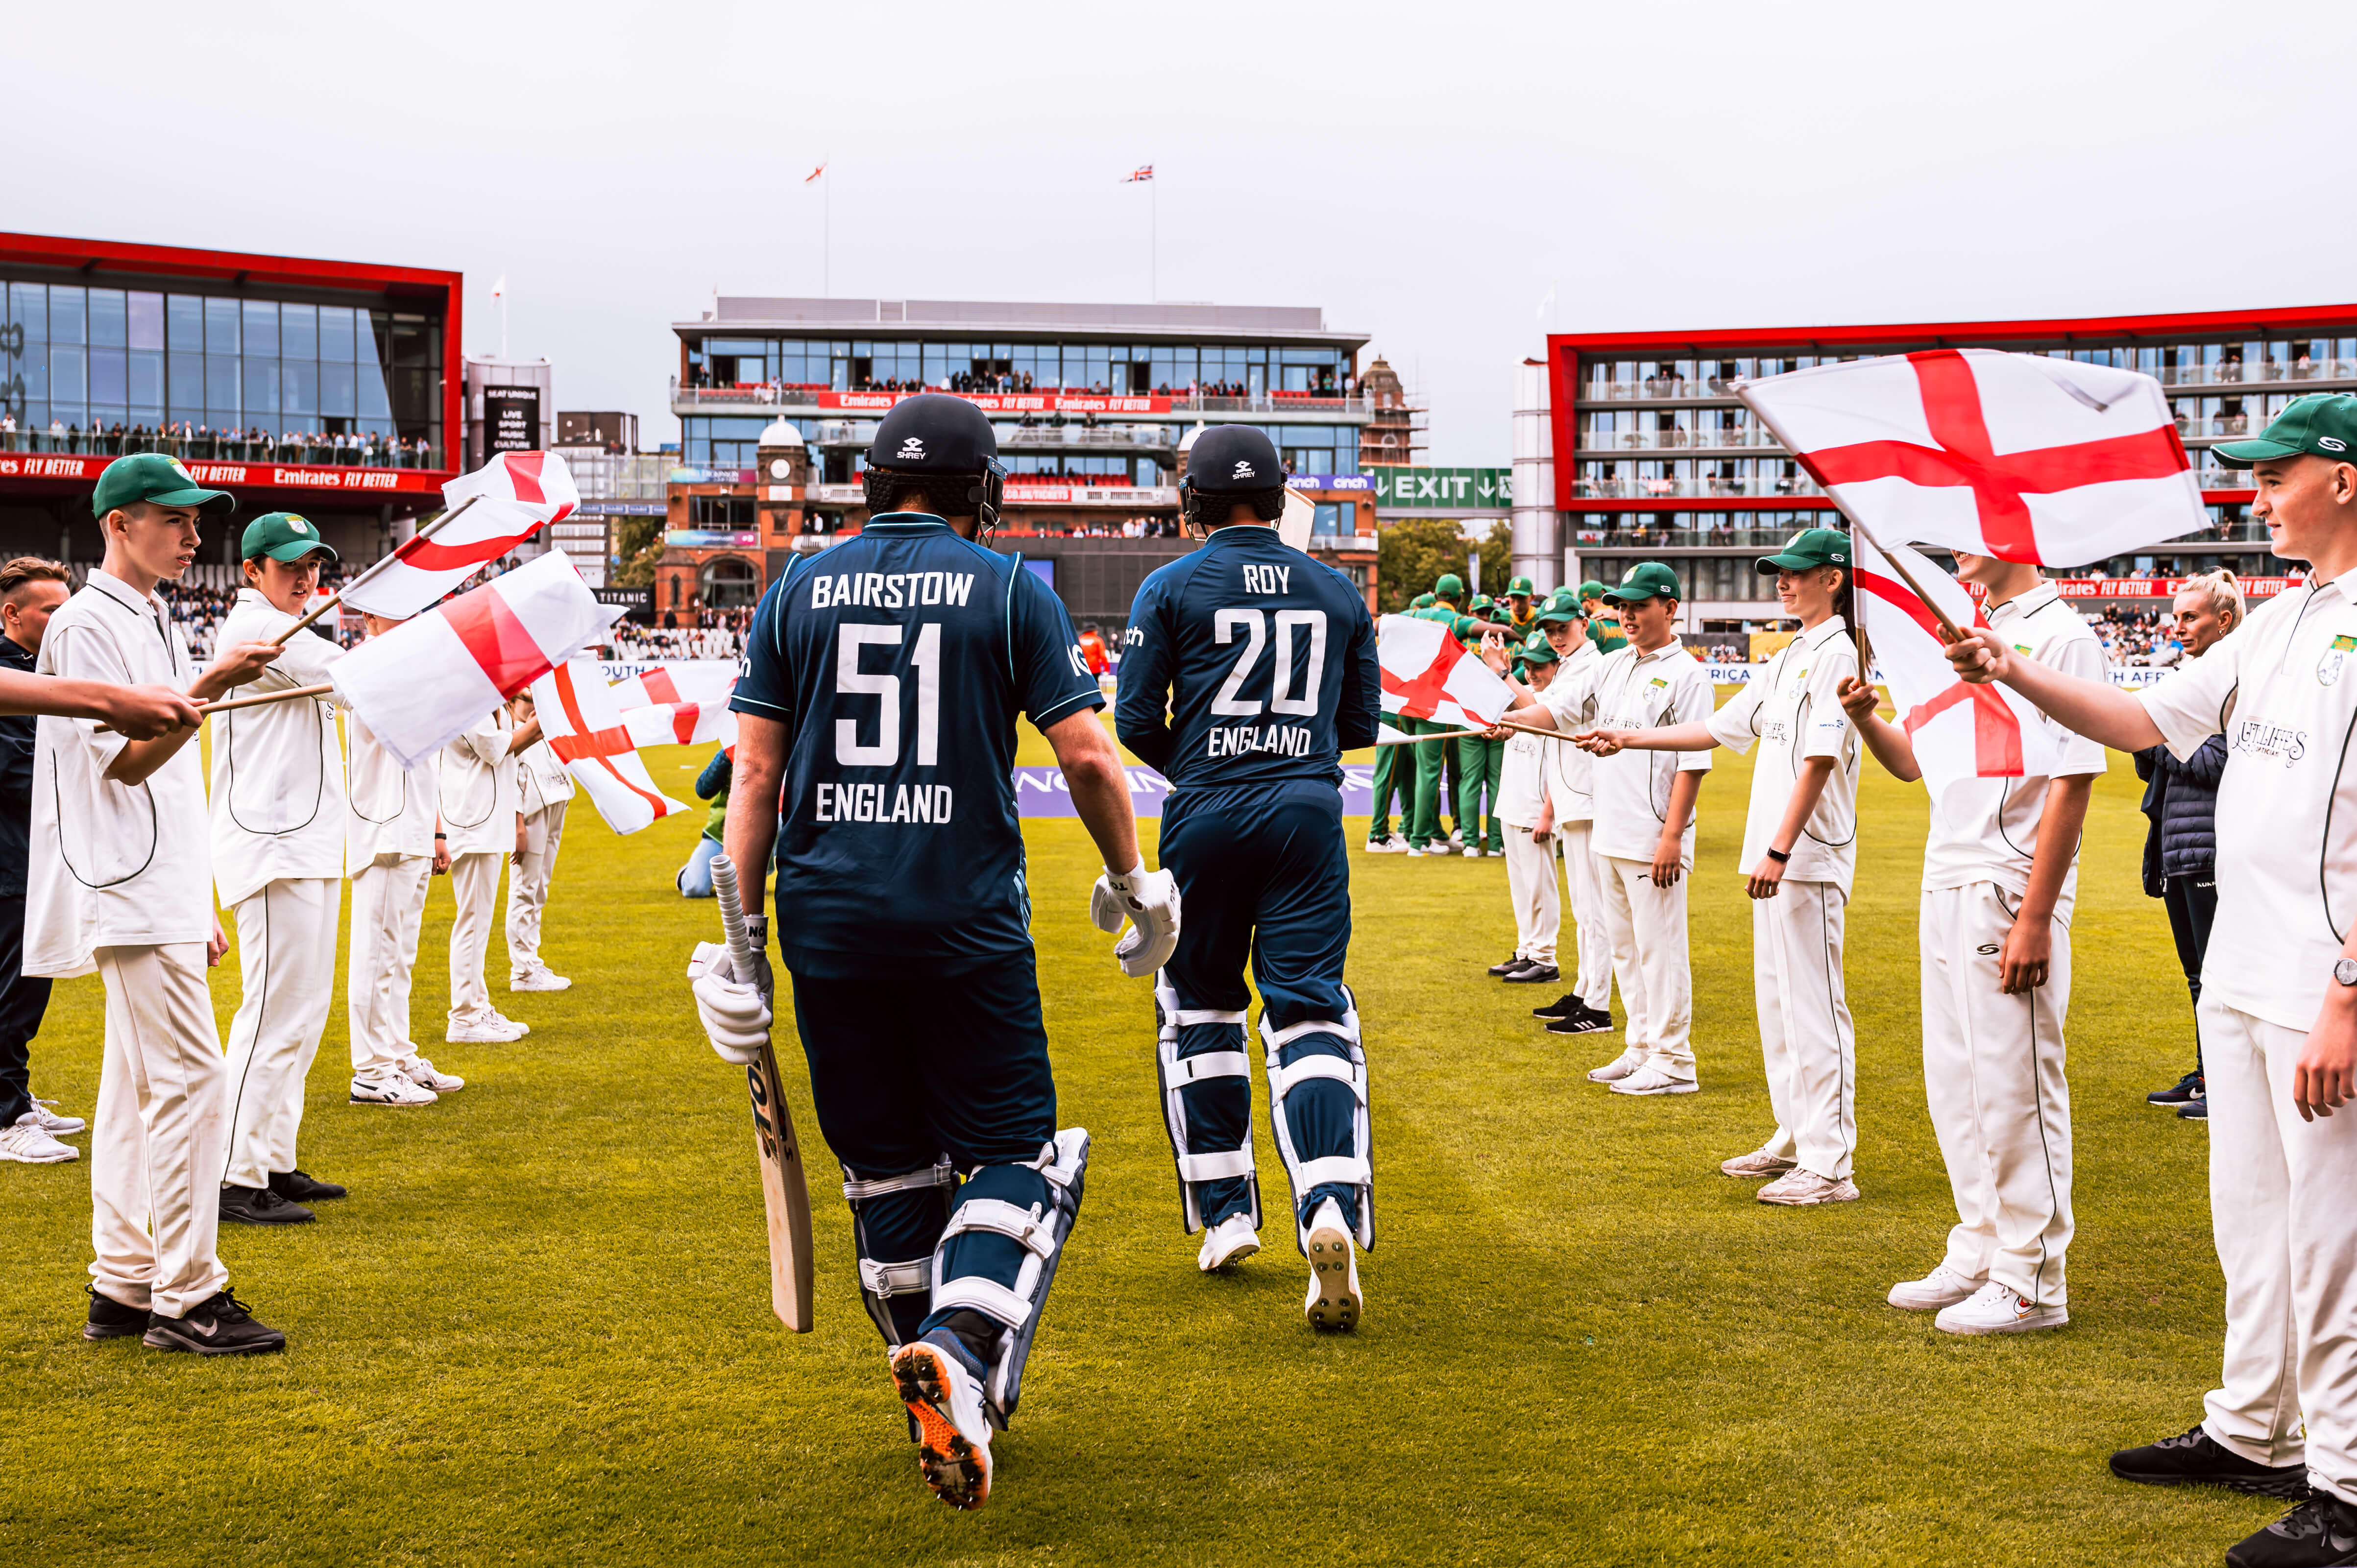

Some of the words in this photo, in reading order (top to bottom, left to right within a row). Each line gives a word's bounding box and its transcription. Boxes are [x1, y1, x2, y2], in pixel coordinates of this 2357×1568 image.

[840, 393, 892, 407] Emirates
[1003, 397, 1017, 410] FLY
[1017, 397, 1044, 410] BETTER
[1055, 398, 1106, 410] Emirates
[1109, 398, 1123, 410] FLY
[1123, 399, 1150, 411] BETTER
[502, 410, 522, 419] LIVE
[498, 420, 527, 429] SPORT
[499, 431, 526, 439] MUSIC
[494, 440, 531, 449] CULTURE
[897, 451, 926, 459] SHREY
[24, 458, 44, 474] FLY
[44, 459, 84, 476] BETTER
[208, 466, 246, 482] BETTER
[274, 468, 340, 486] Emirates
[344, 472, 364, 487] FLY
[363, 473, 398, 488] BETTER
[1232, 471, 1255, 480] SHREY
[1333, 476, 1368, 489] cinch
[1395, 476, 1472, 499] EXIT
[1242, 564, 1289, 594] ROY
[811, 572, 974, 609] BAIRSTOW
[2100, 581, 2117, 595] FLY
[2117, 581, 2152, 596] BETTER
[599, 592, 647, 603] TITANIC
[1211, 609, 1327, 716] 20
[836, 623, 941, 766] 51
[1208, 724, 1312, 757] ENGLAND
[816, 783, 952, 823] ENGLAND
